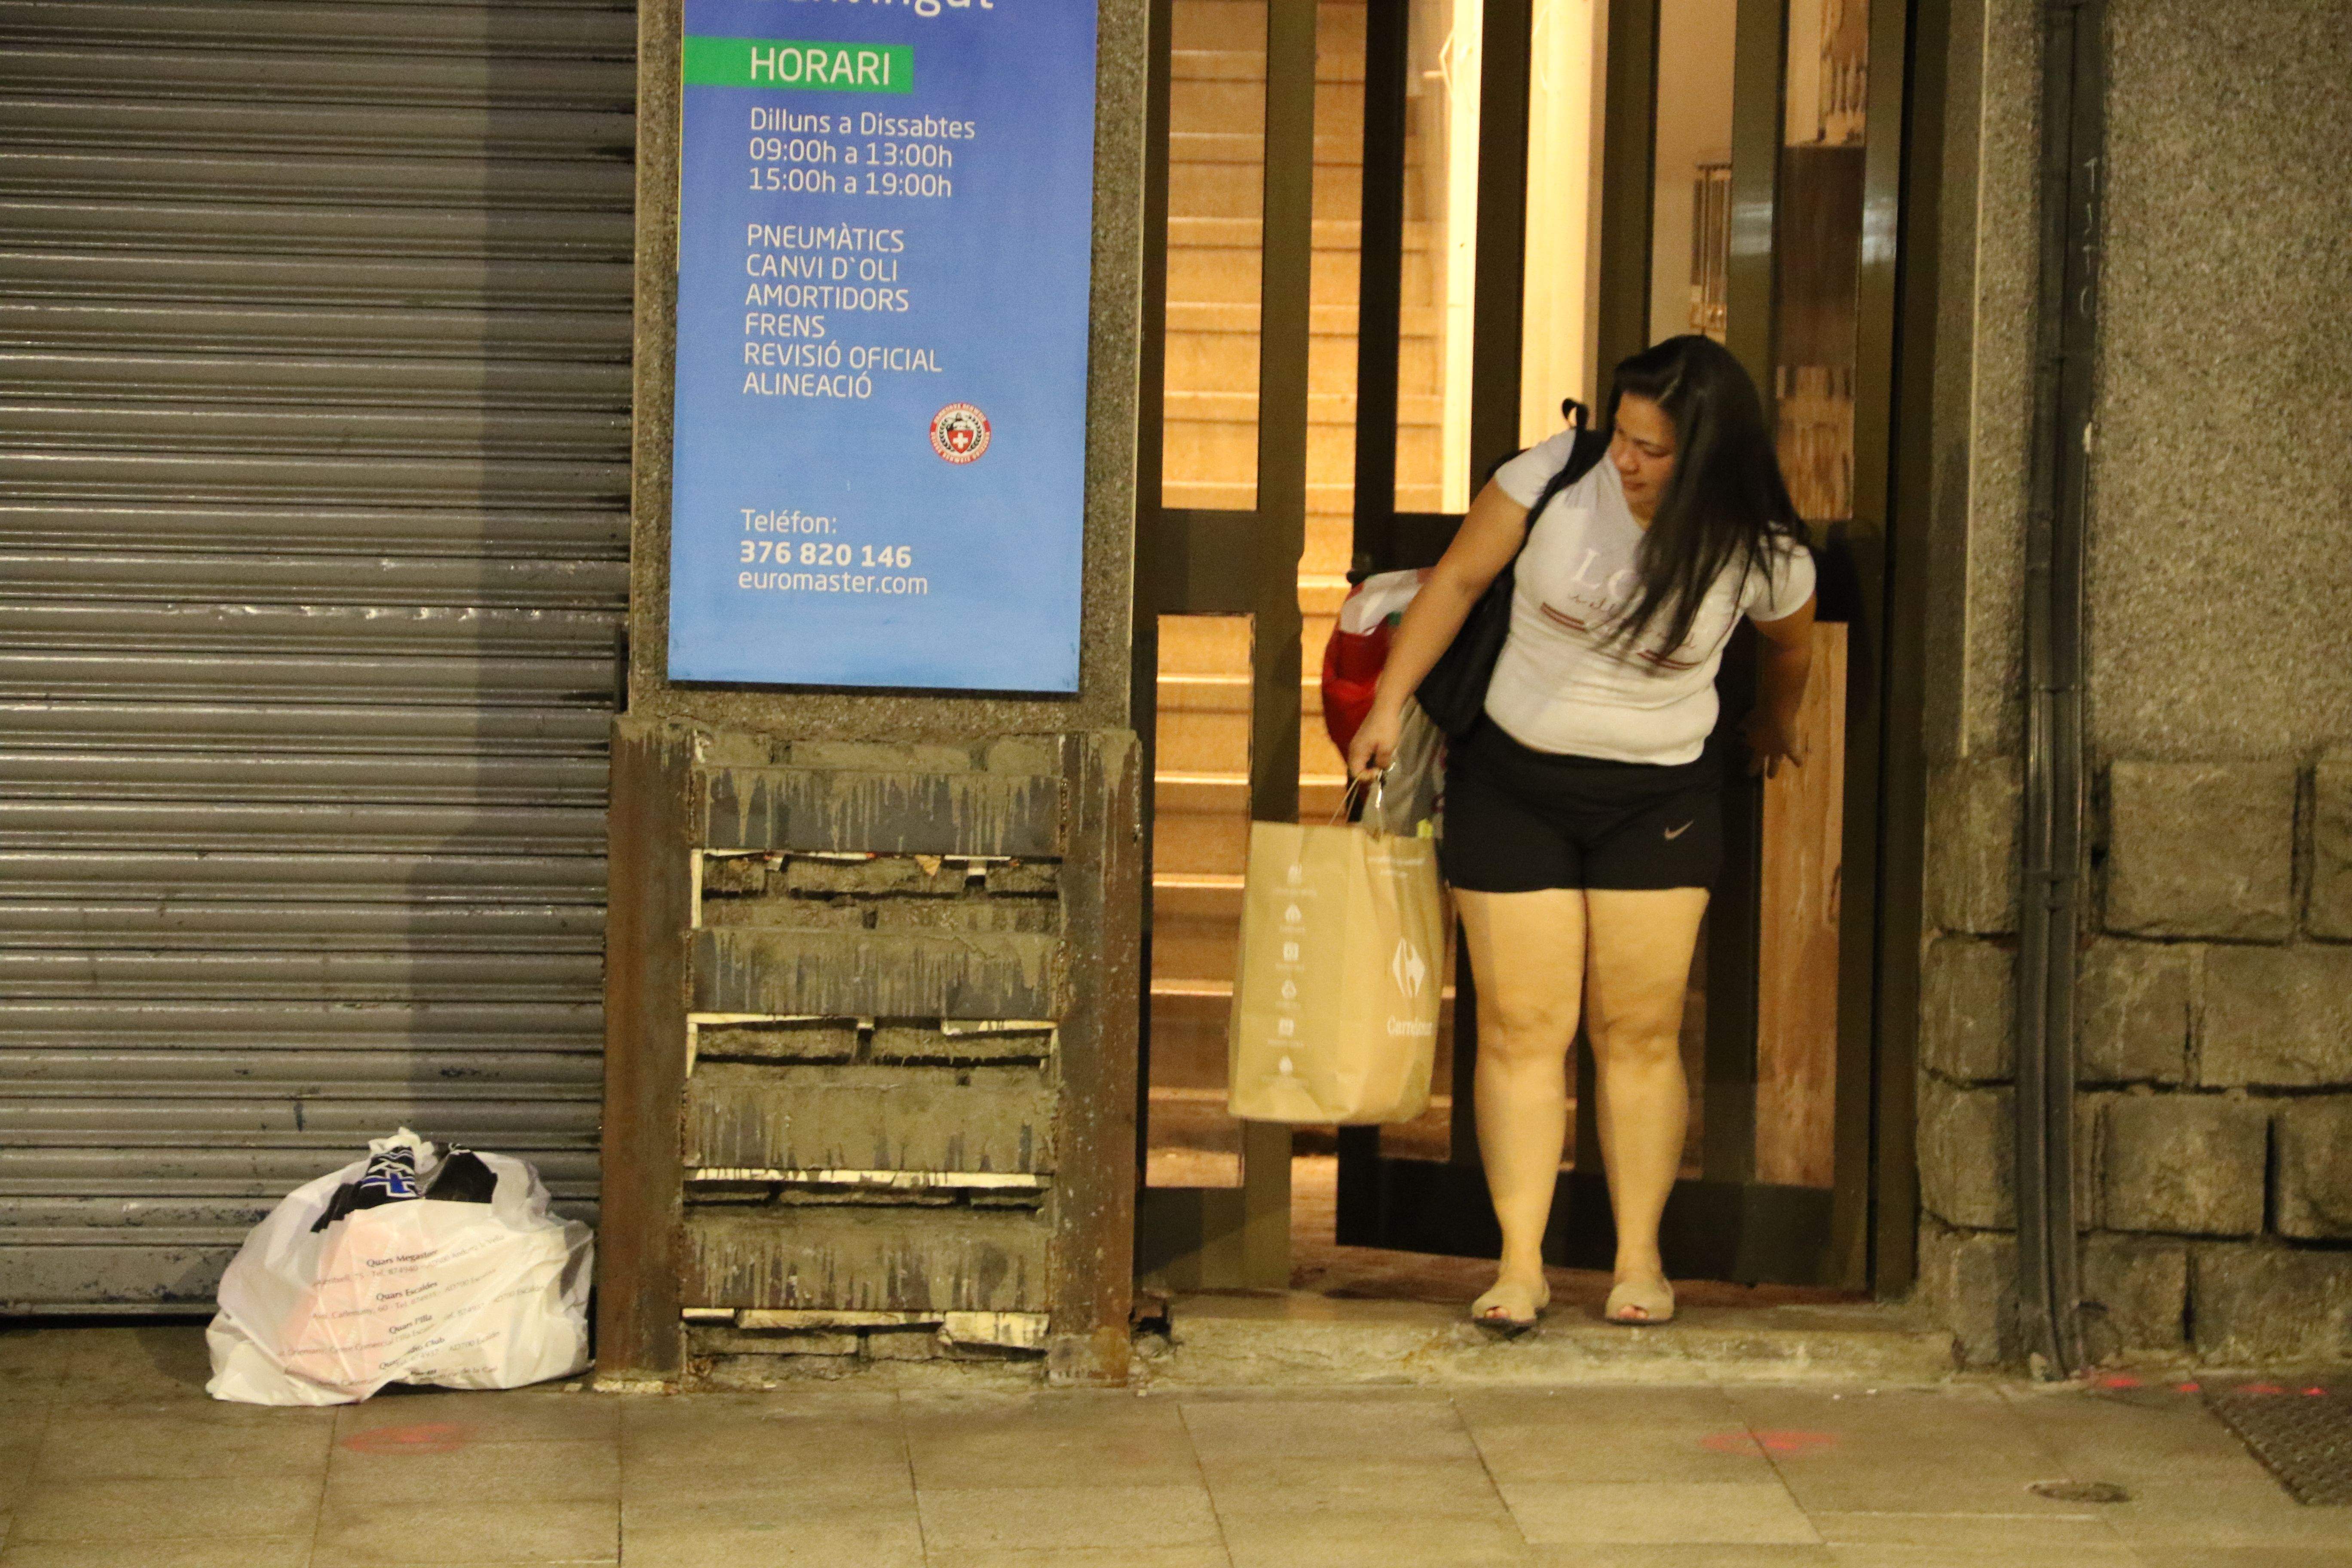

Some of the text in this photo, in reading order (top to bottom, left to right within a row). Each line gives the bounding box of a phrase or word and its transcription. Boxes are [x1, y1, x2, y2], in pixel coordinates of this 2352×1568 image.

[750, 46, 890, 86] HORARI
[750, 106, 976, 140] Dilluns a Dissabtes
[749, 136, 952, 168] 09:00h a 13:00h
[749, 167, 952, 198] 15:00h a 19:00h
[747, 222, 905, 254] PNEUMÀTICS
[746, 253, 823, 279] CANVI
[744, 282, 910, 312] AMORTIDORS
[744, 312, 825, 338] FRENS
[744, 340, 943, 373] REVISIÓ OFICIAL
[742, 370, 872, 399] ALINEACIÓ
[740, 508, 837, 534] Teléfon:
[740, 539, 912, 569] 376 820 146
[738, 571, 928, 595] euromaster.com
[376, 1290, 403, 1302] Quars
